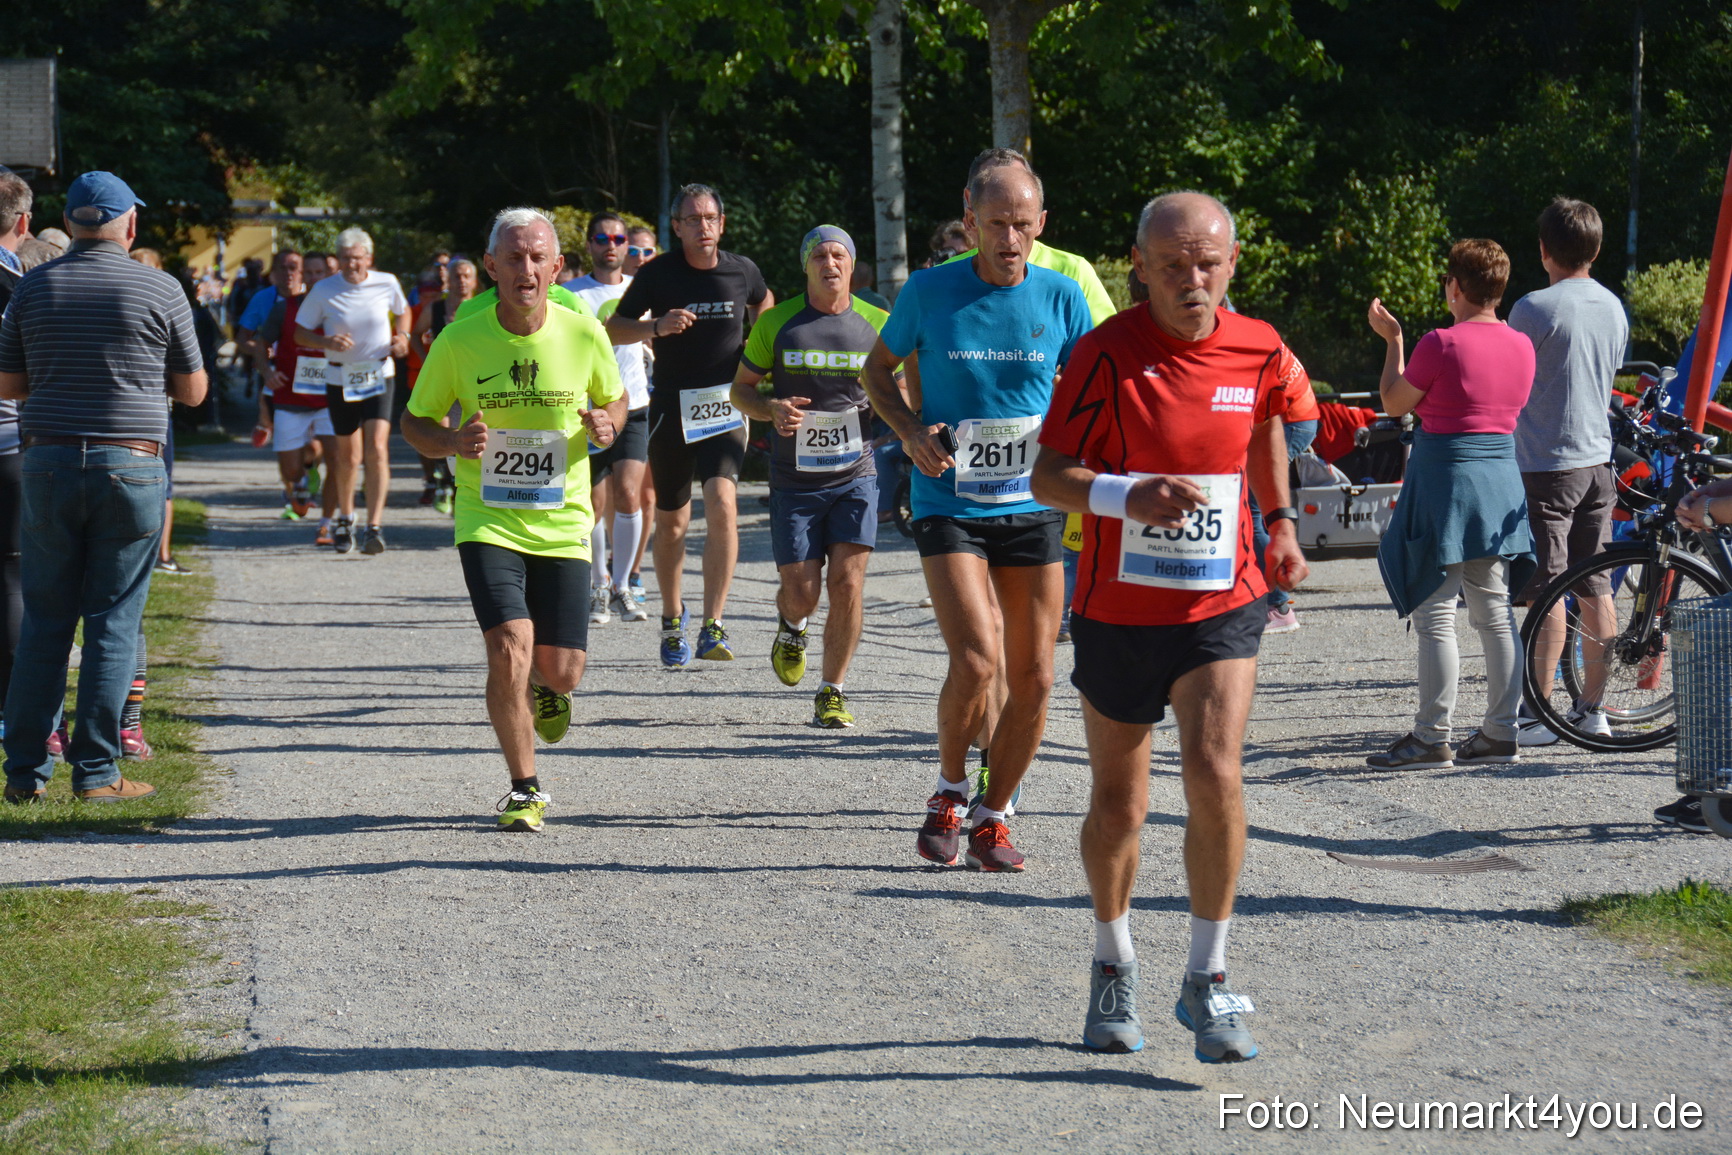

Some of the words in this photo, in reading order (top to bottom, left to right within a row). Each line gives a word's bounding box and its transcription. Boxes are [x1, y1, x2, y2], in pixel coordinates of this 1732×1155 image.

[782, 349, 869, 370] BOCK
[948, 349, 1045, 362] www.hasit.de
[477, 391, 490, 399] SC
[1211, 386, 1255, 404] JURA
[690, 401, 732, 420] 2325
[806, 425, 849, 447] 2531
[981, 425, 1020, 436] BOCK
[506, 436, 543, 447] BOCK
[968, 440, 1027, 468] 2611
[494, 451, 554, 476] 2294
[978, 480, 1020, 493] Manfred
[507, 489, 540, 500] Alfons
[1147, 544, 1172, 554] PARTL
[1154, 560, 1207, 577] Herbert
